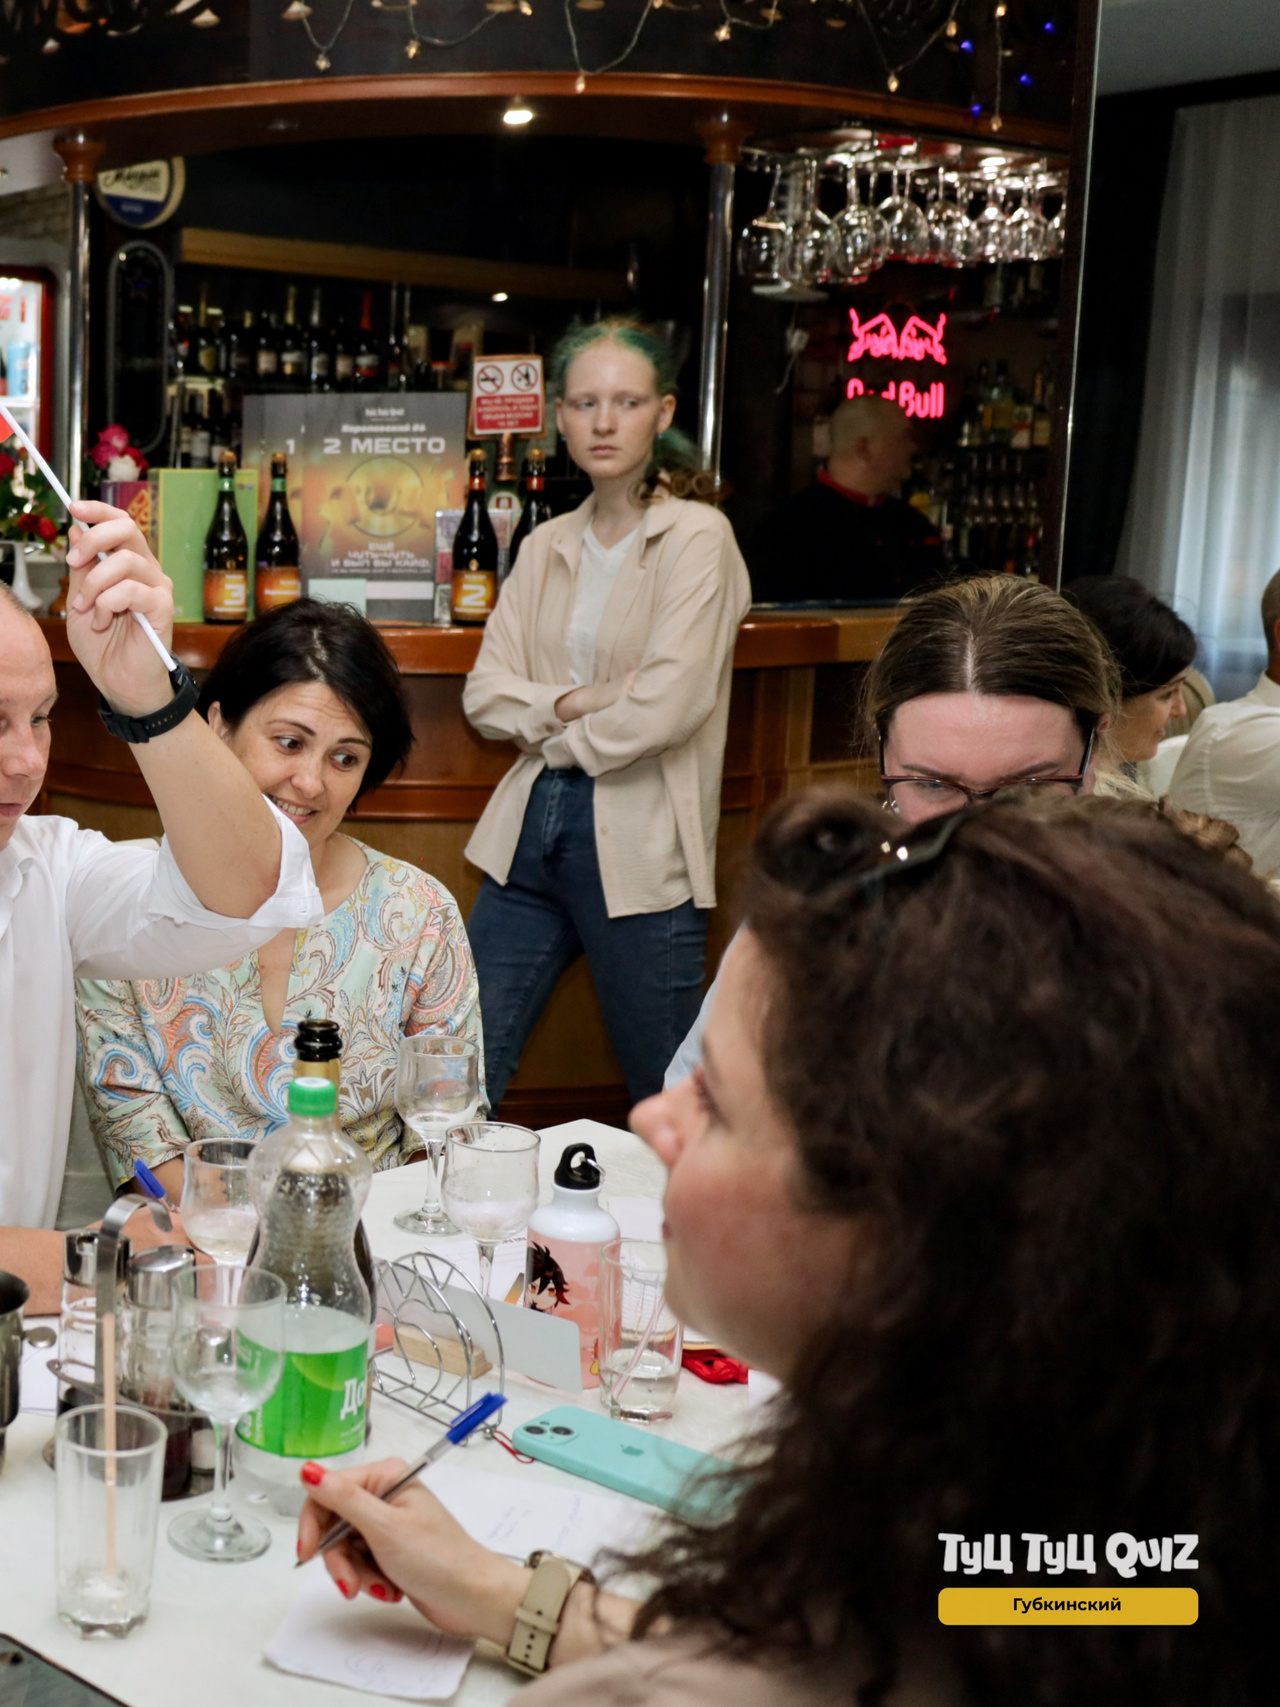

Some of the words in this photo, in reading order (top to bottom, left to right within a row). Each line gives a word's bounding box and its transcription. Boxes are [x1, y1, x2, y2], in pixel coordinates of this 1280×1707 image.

[323, 438, 341, 454] 2
[351, 437, 446, 454] МЕСТО
[462, 584, 486, 606] 2
